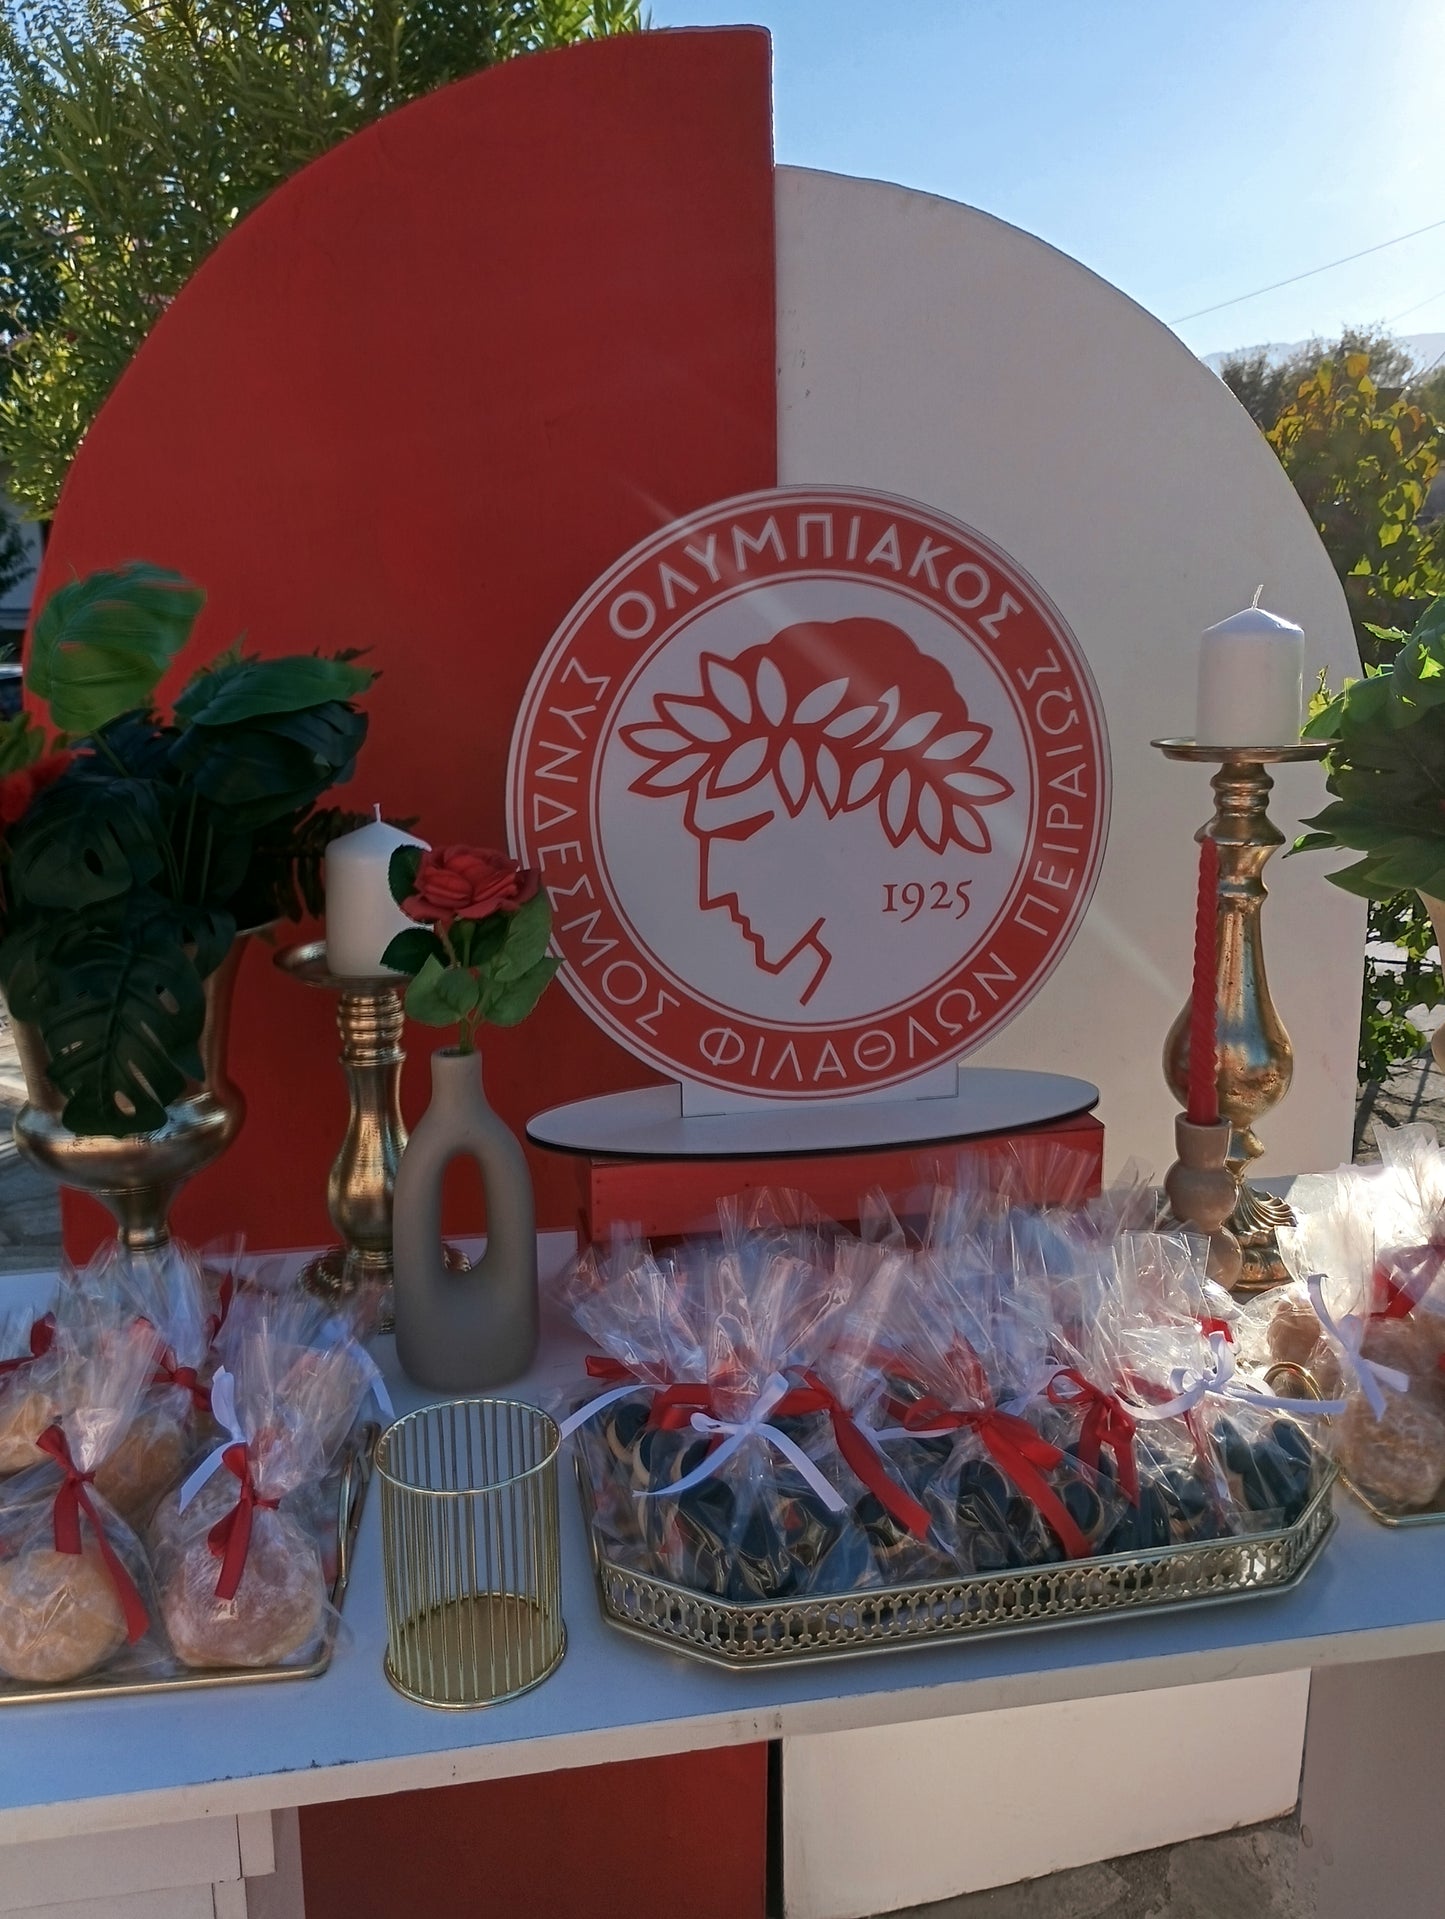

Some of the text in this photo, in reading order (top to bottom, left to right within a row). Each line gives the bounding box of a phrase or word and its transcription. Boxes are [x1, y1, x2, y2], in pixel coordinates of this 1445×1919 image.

[608, 512, 1022, 640] ΟΛΥΜΠΙΑΚΟΣ
[533, 648, 1089, 1083] ΣΥΝΔΕΣΜΟΣ ΦΙΛΑΘΛΩΝ ΠΕΙΡΑΙΩΣ
[881, 878, 974, 923] 1925
